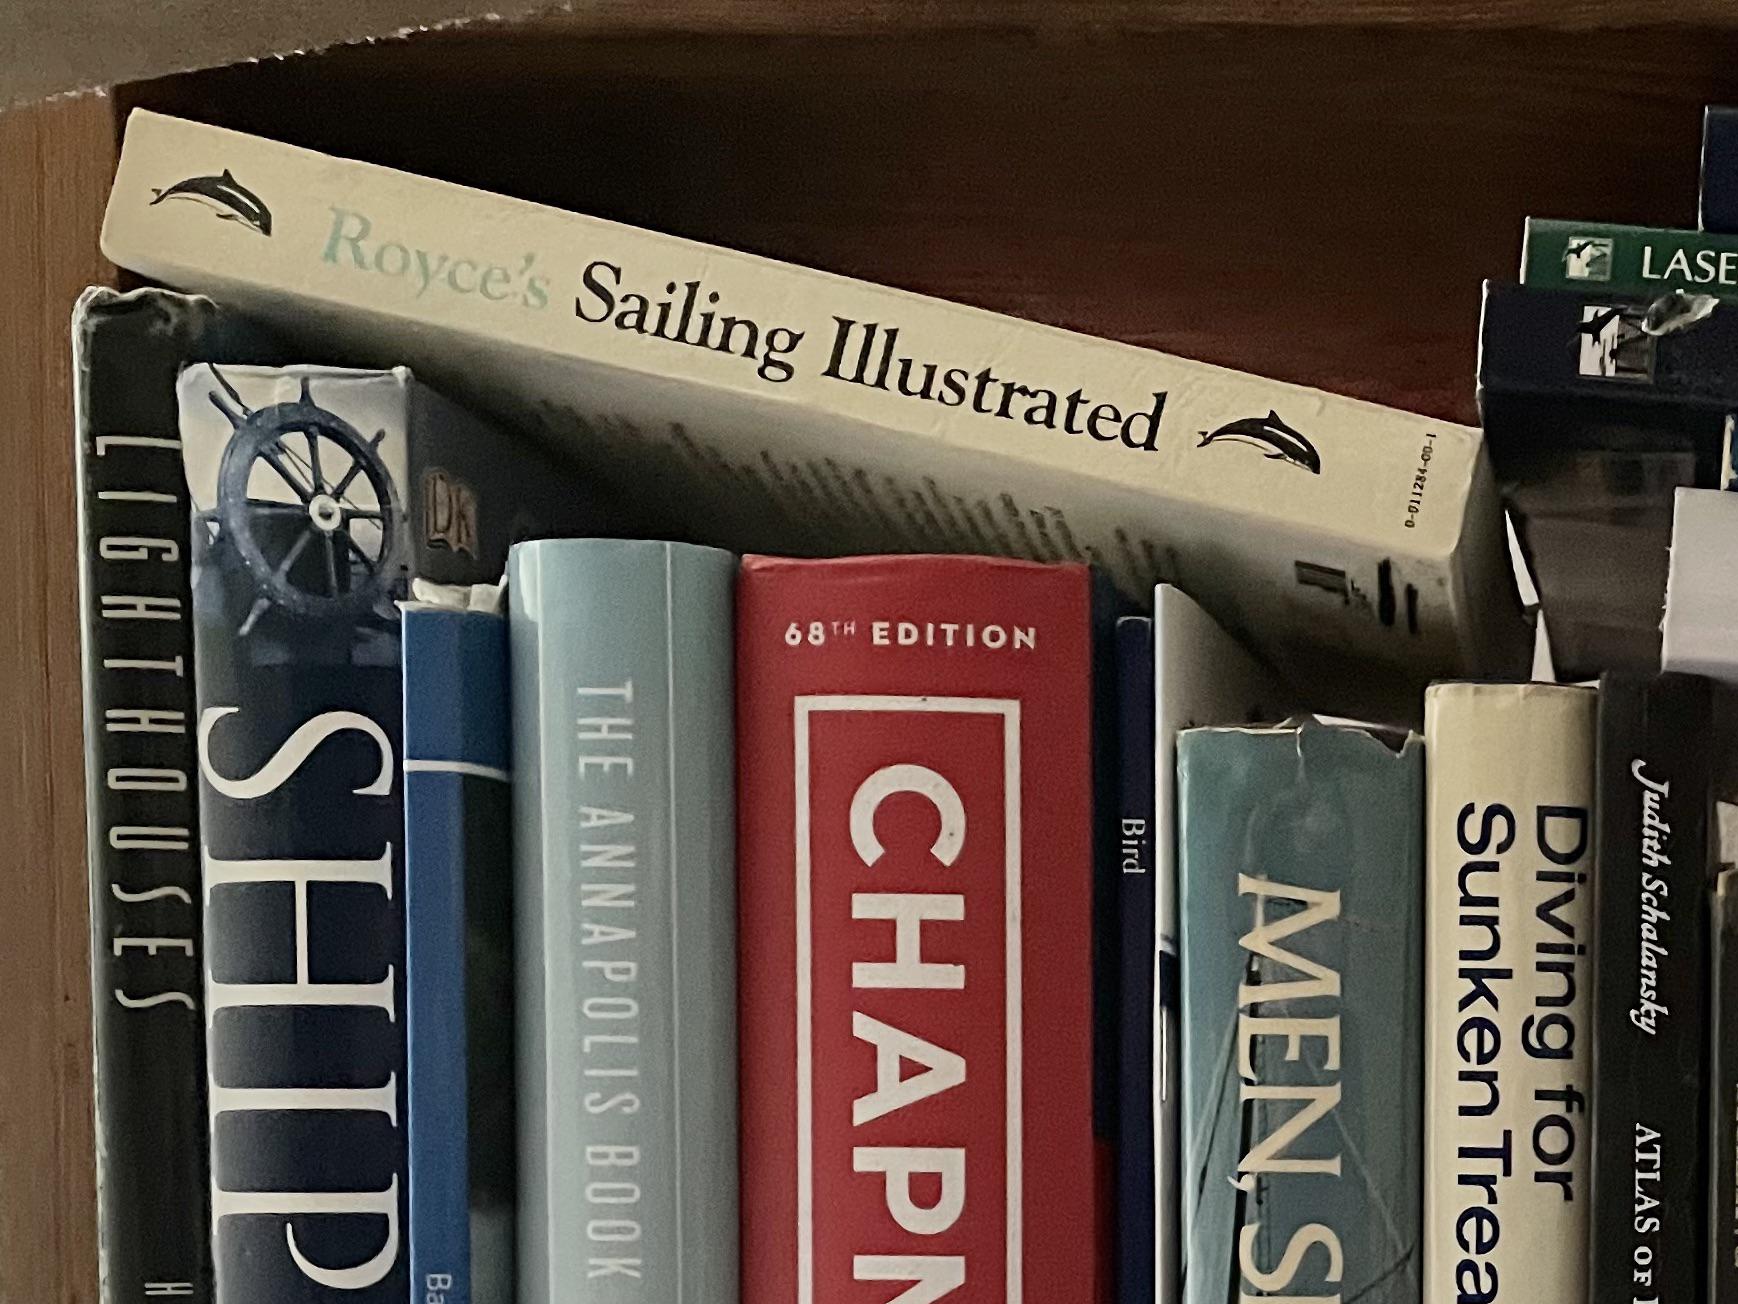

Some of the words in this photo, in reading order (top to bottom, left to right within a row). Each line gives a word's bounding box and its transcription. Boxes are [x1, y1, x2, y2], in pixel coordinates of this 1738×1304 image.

[320, 206, 551, 310] Royce's
[574, 260, 804, 383] Sailing
[821, 315, 1168, 452] Illustrated
[785, 620, 856, 646] 68TH
[872, 621, 1036, 650] EDITION
[96, 435, 197, 1011] LIGHTHOUSES
[576, 680, 634, 780] THE
[1121, 817, 1146, 876] Bird
[1631, 758, 1671, 868] Judith
[199, 706, 400, 1290] SHIP
[579, 805, 641, 1115] ANNAPOLIS
[1456, 801, 1516, 1118] Sunken
[1522, 804, 1589, 1061] Diving
[1629, 874, 1671, 1036] Schalansky
[1226, 871, 1342, 1191] MEN,
[585, 1145, 642, 1280] BOOK
[1532, 1082, 1587, 1202] for
[1634, 1123, 1662, 1233] ATLAS
